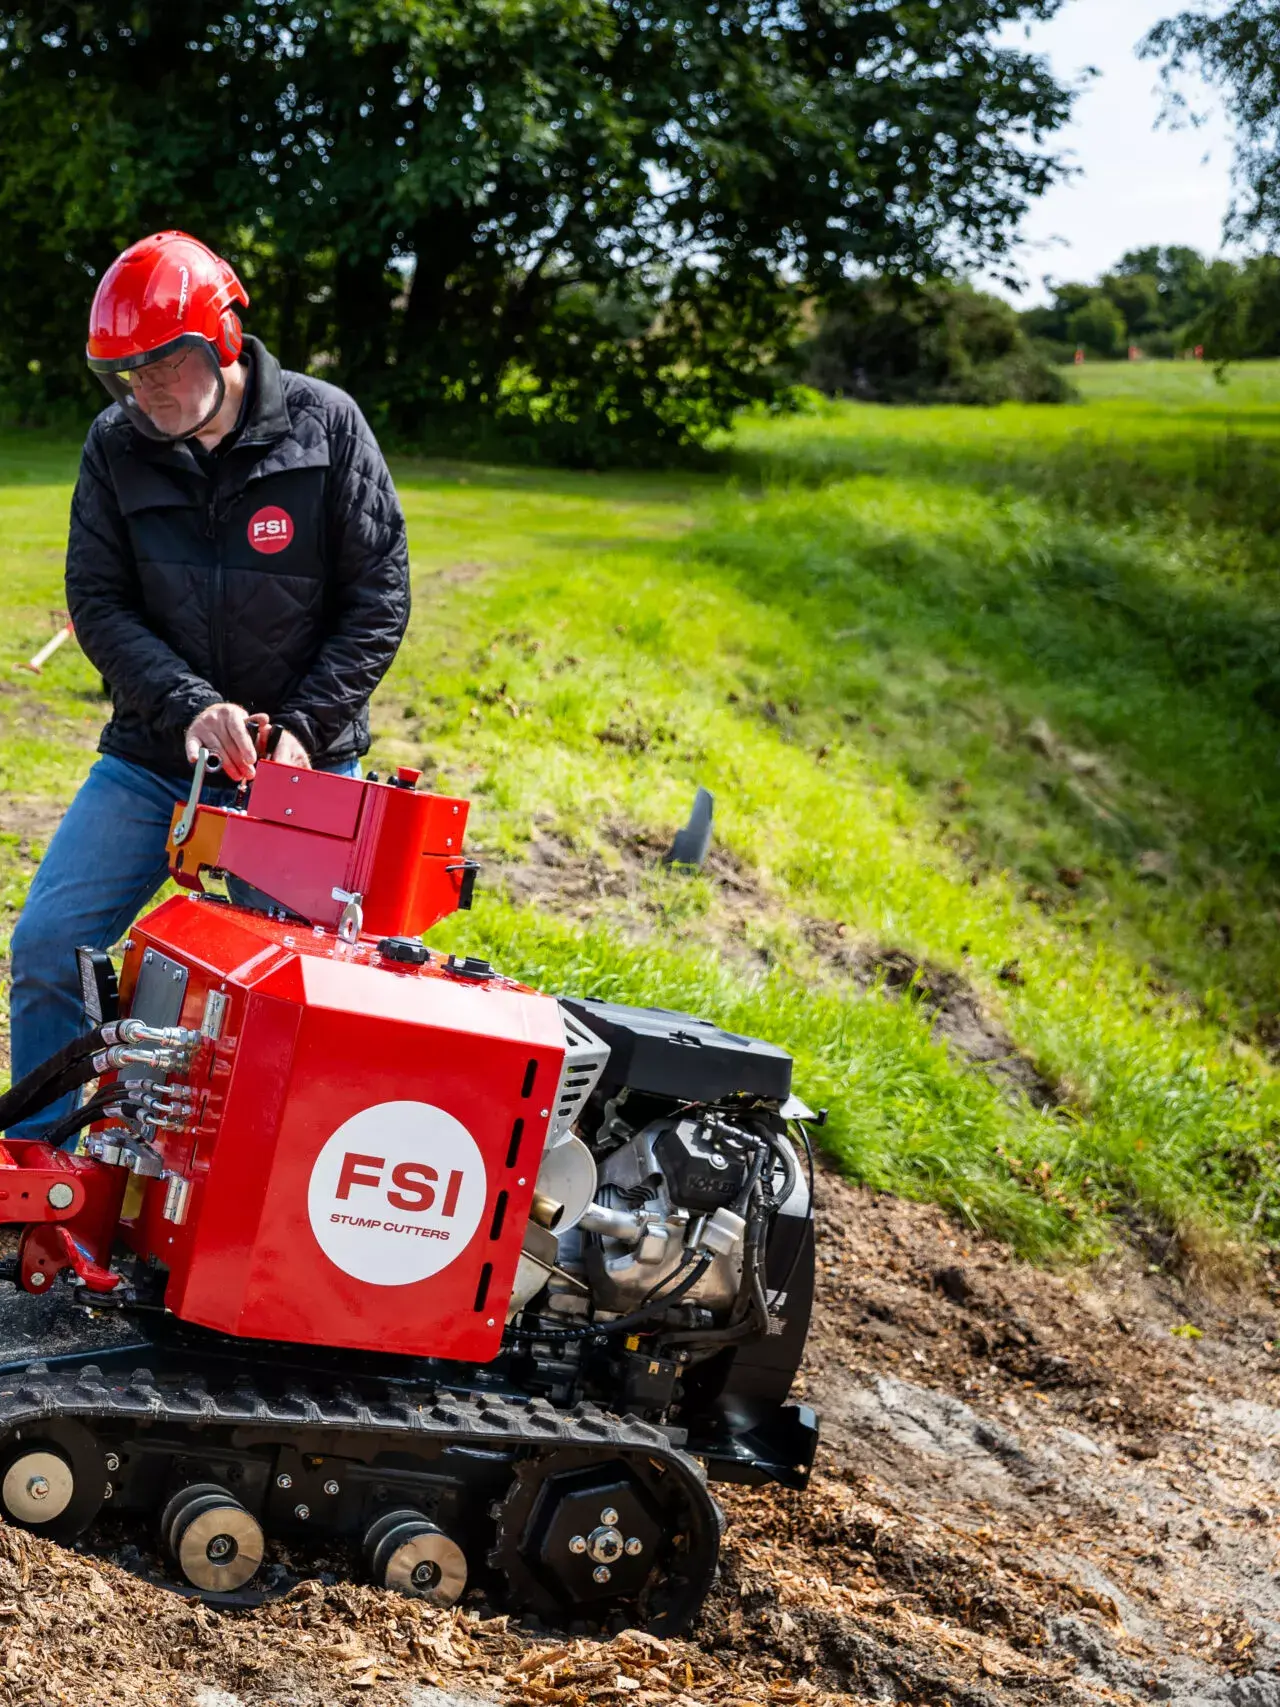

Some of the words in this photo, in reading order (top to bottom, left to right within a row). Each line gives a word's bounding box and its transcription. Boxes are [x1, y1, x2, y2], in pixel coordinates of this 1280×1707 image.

[253, 519, 287, 537] FSI
[335, 1152, 464, 1218] FSI
[329, 1213, 381, 1229] STUMP
[383, 1222, 451, 1241] CUTTERS
